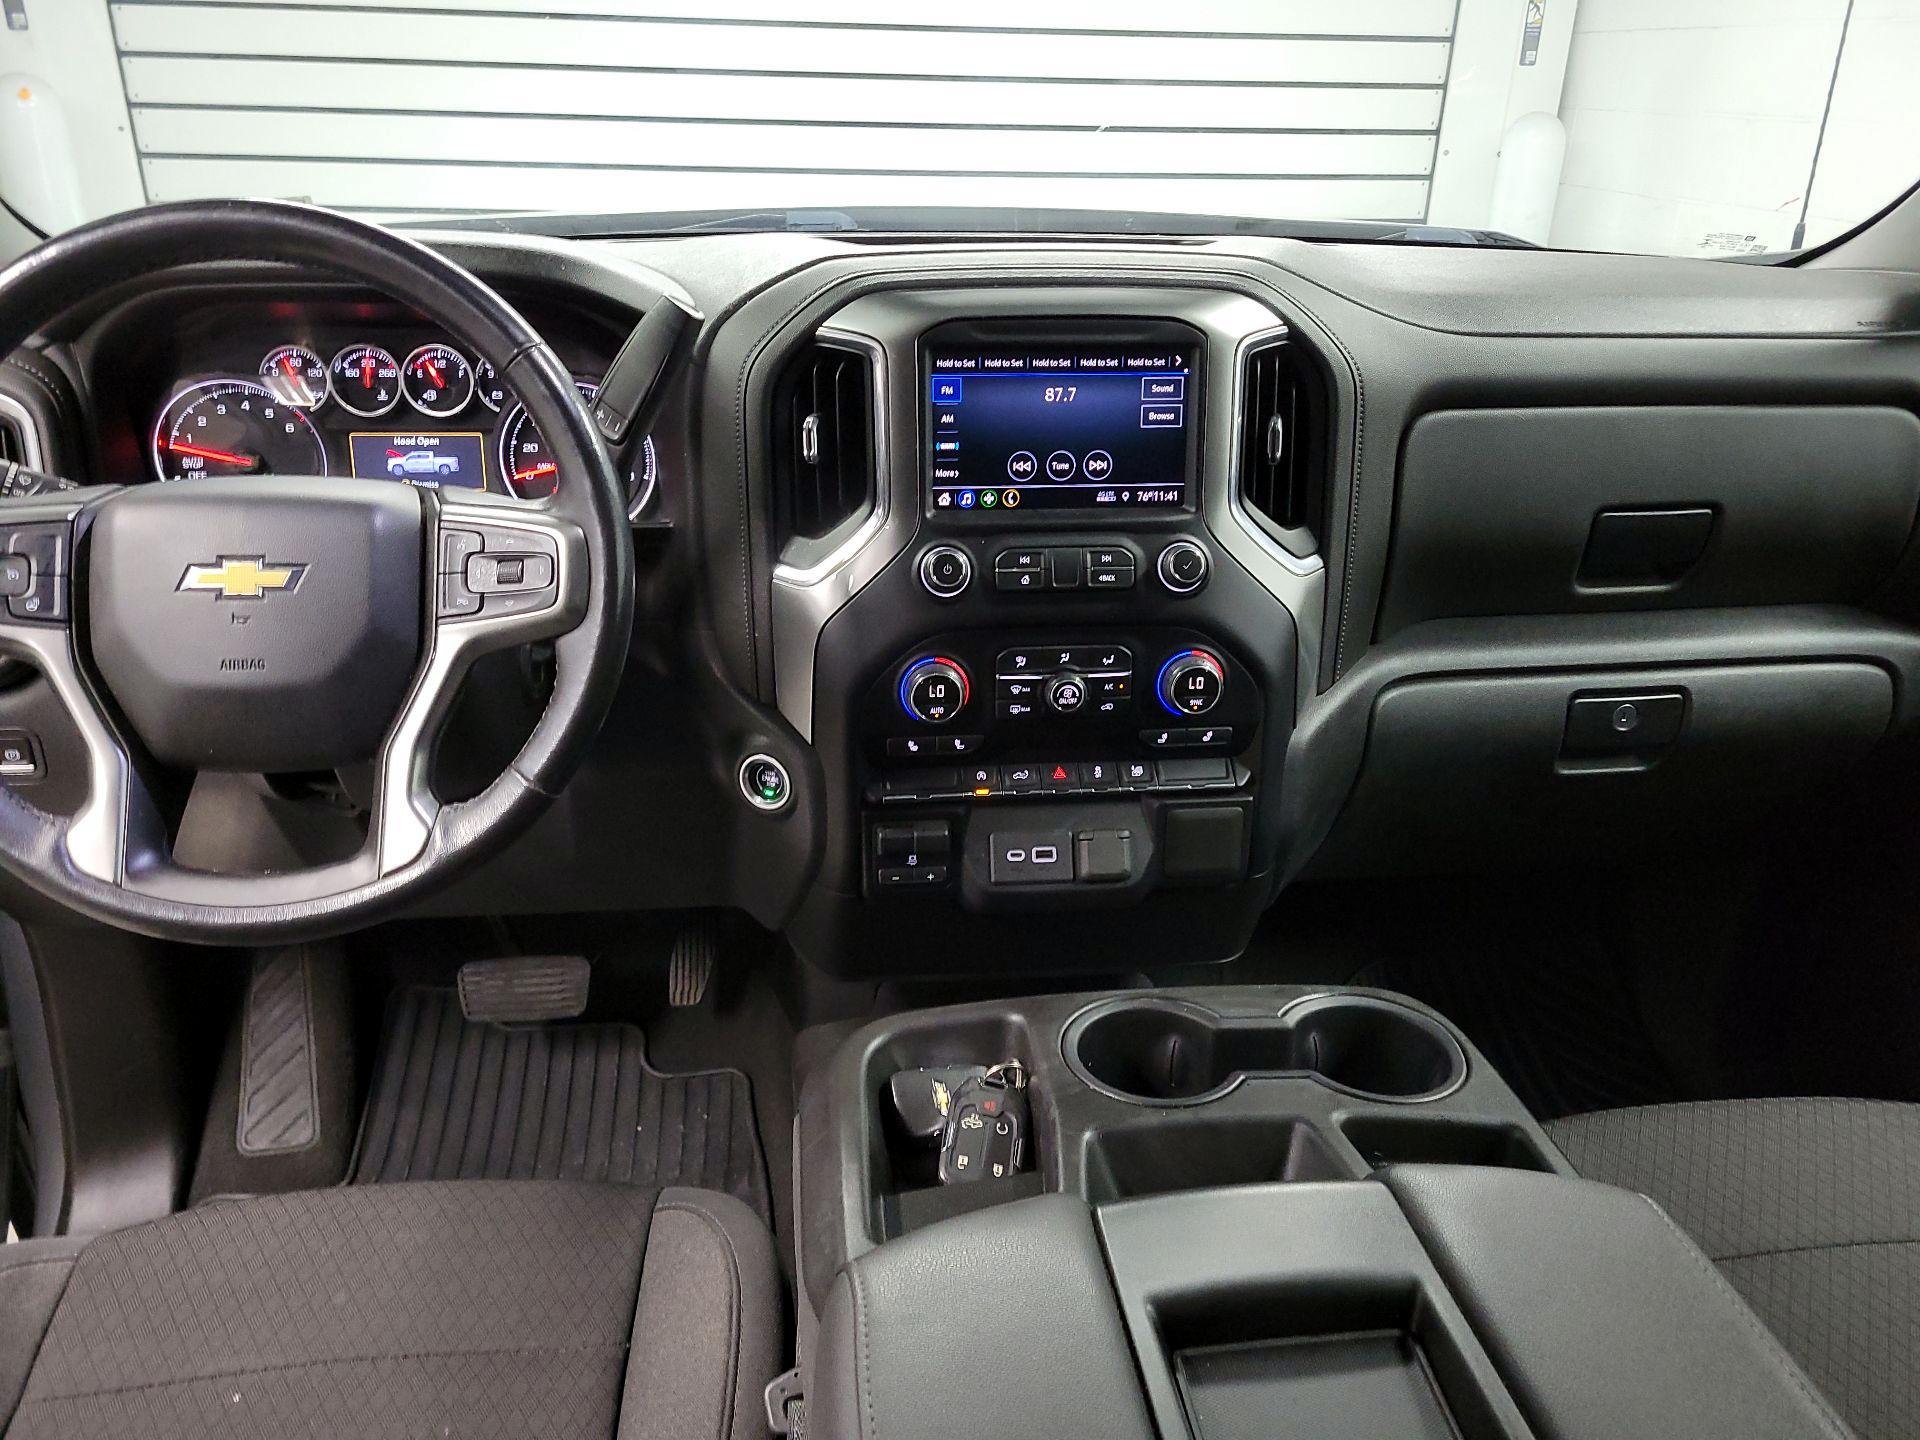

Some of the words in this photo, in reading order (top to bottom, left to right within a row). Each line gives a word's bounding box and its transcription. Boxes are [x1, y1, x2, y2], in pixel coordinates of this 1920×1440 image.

[361, 359, 375, 367] 20
[434, 360, 446, 368] 1/2
[936, 359, 953, 368] Hold
[954, 360, 962, 368] to
[963, 359, 975, 368] Set
[984, 359, 1001, 367] Hold
[1011, 359, 1023, 367] Set
[1032, 359, 1049, 367] Hold
[1059, 359, 1071, 367] Set
[1080, 358, 1097, 367] Hold
[1097, 359, 1105, 367] to
[1106, 358, 1118, 367] Set
[1127, 358, 1144, 366] Hold
[1154, 358, 1165, 366] Set
[272, 368, 279, 376] 0
[307, 368, 322, 377] 120
[344, 369, 359, 377] 160
[379, 369, 396, 377] 260
[941, 386, 953, 395] FM
[1151, 384, 1174, 393] Sound
[1045, 387, 1077, 402] 87.7
[217, 404, 226, 414] 3
[241, 401, 250, 411] 4
[265, 408, 274, 418] 5
[1149, 412, 1174, 420] Browse
[197, 416, 207, 426] 2
[941, 414, 954, 423] AM
[285, 423, 295, 433] 6
[186, 433, 192, 443] 1
[393, 436, 416, 446] Hood
[417, 436, 439, 447] Open
[522, 443, 538, 453] 20
[1052, 461, 1069, 470] Tune
[935, 469, 954, 478] More
[1153, 490, 1178, 502] 11:41
[220, 659, 265, 670] AIRBAG
[1188, 677, 1204, 689] LO
[929, 685, 945, 697] LO
[930, 706, 944, 714] AUTO
